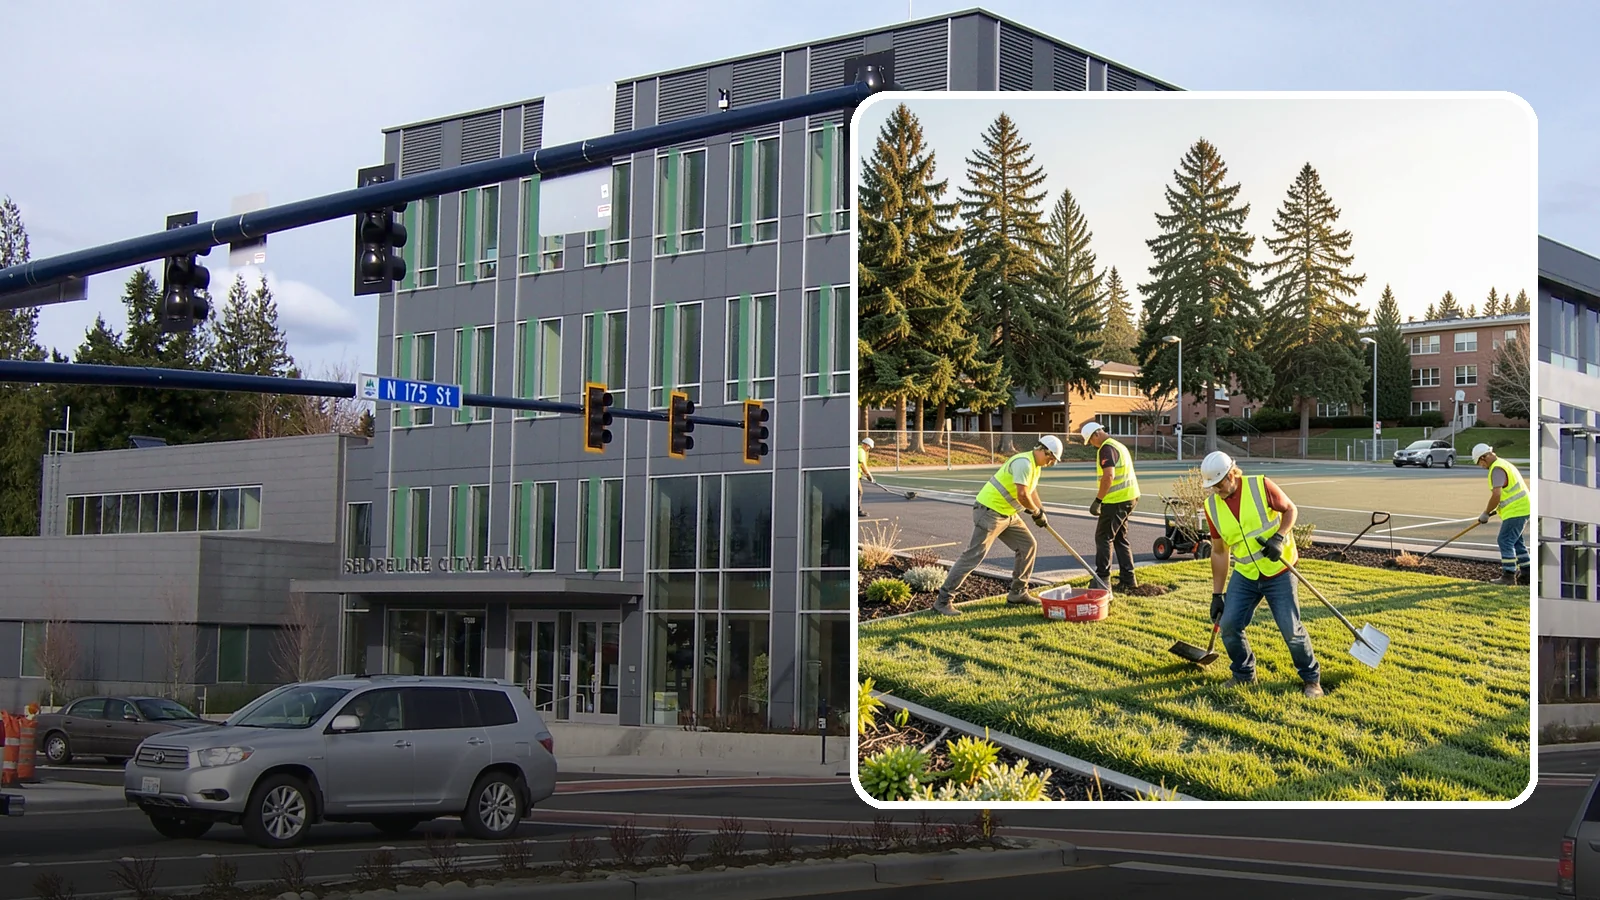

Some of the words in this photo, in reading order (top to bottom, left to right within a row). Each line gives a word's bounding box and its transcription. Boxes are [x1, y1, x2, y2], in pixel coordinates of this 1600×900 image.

[387, 380, 396, 400] N
[405, 382, 428, 403] 175
[436, 386, 451, 406] St
[344, 557, 432, 574] SHORELINE
[438, 556, 477, 572] CITY
[484, 555, 525, 572] HALL
